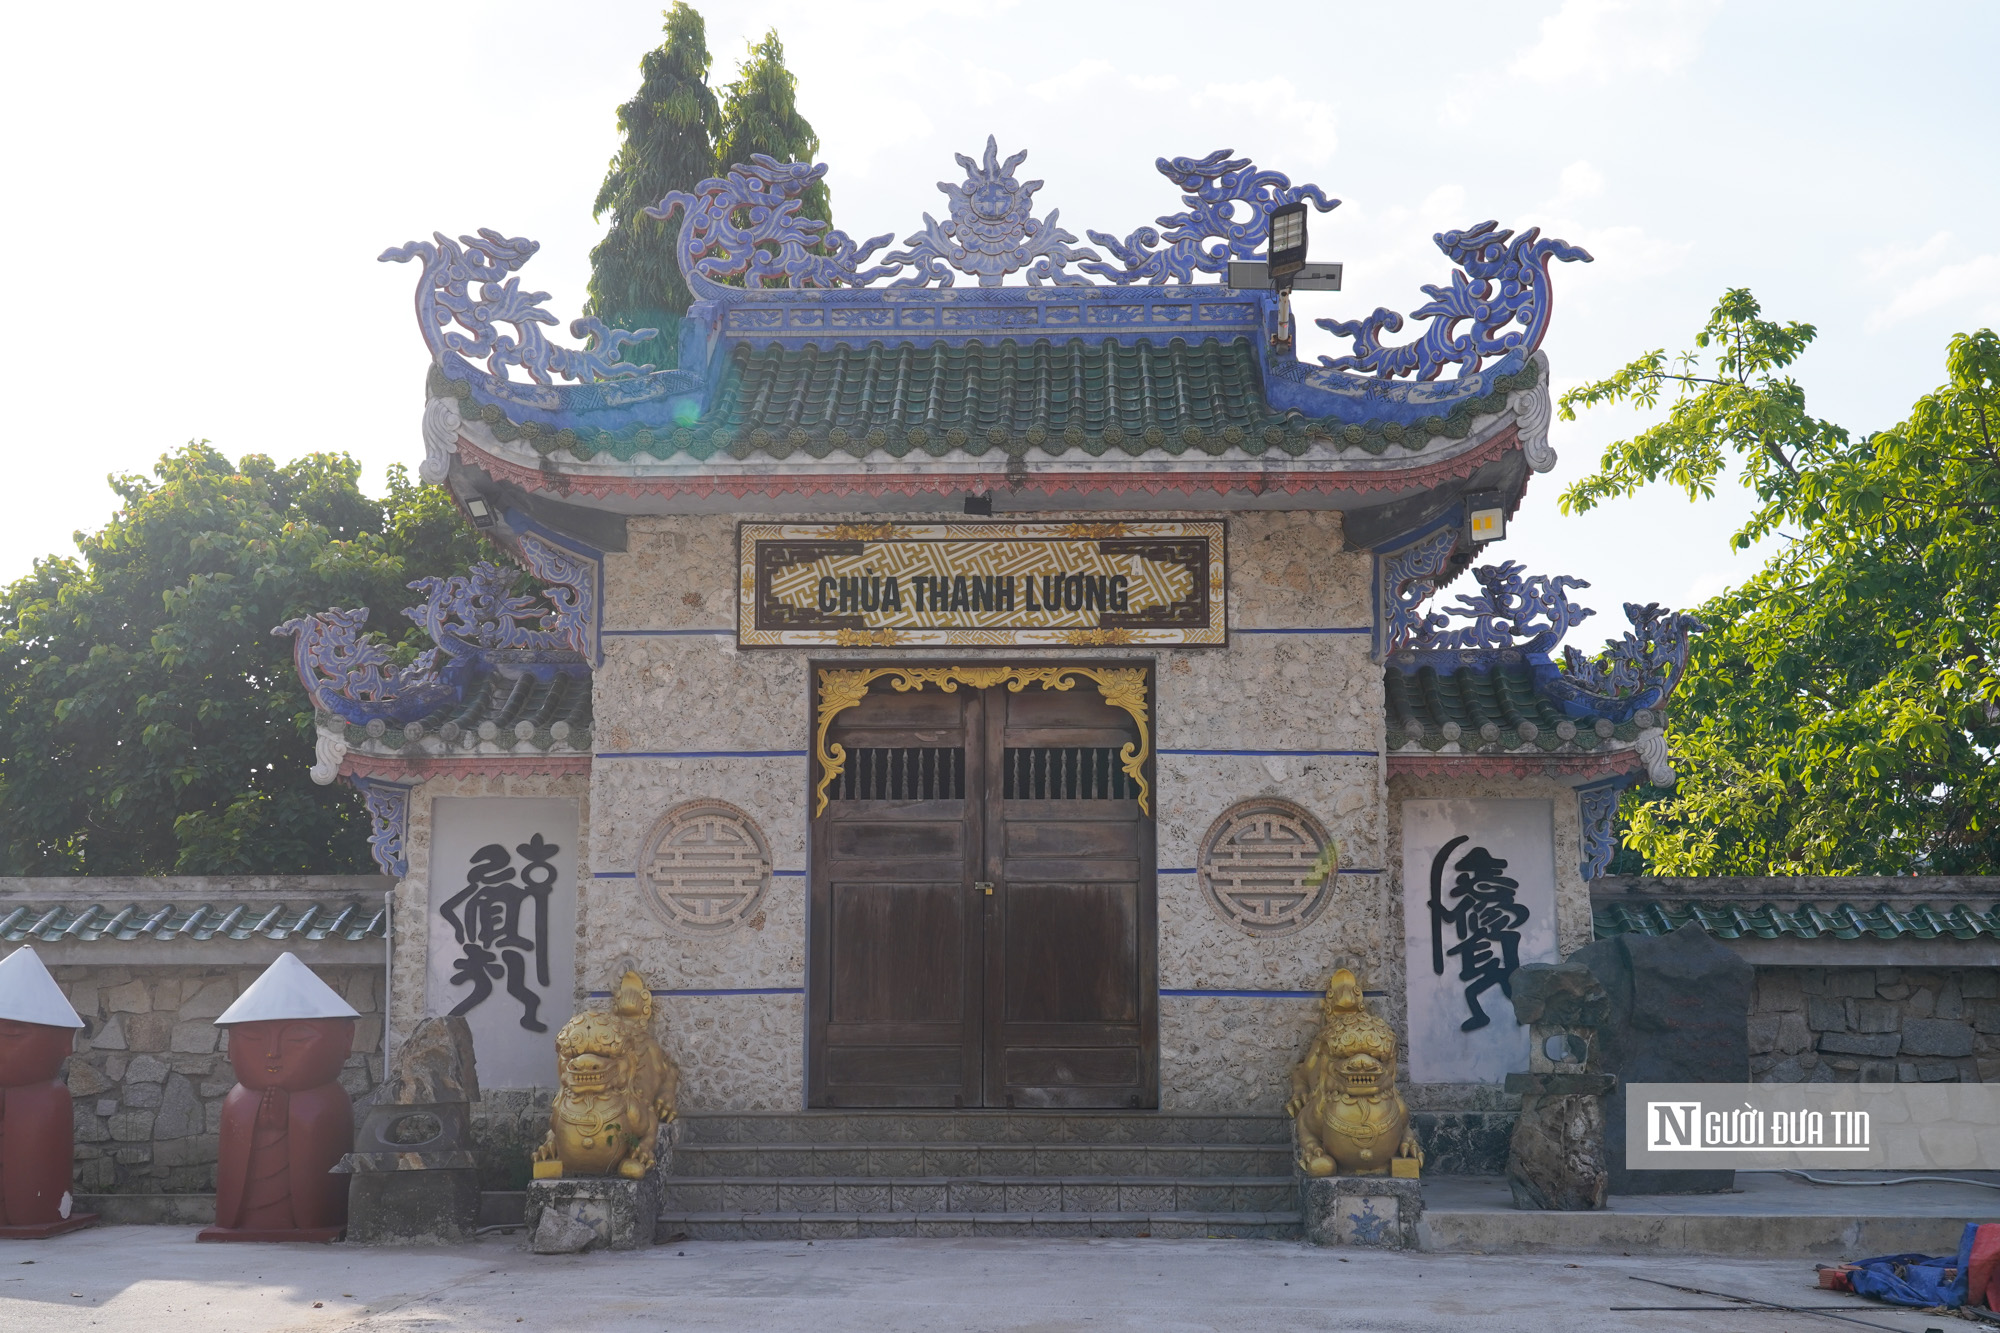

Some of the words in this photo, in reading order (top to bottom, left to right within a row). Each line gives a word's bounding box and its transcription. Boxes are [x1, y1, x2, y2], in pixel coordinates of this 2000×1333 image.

[818, 567, 902, 613] CHÙA
[911, 575, 1015, 612] THANH
[1026, 571, 1128, 612] LƯƠNG
